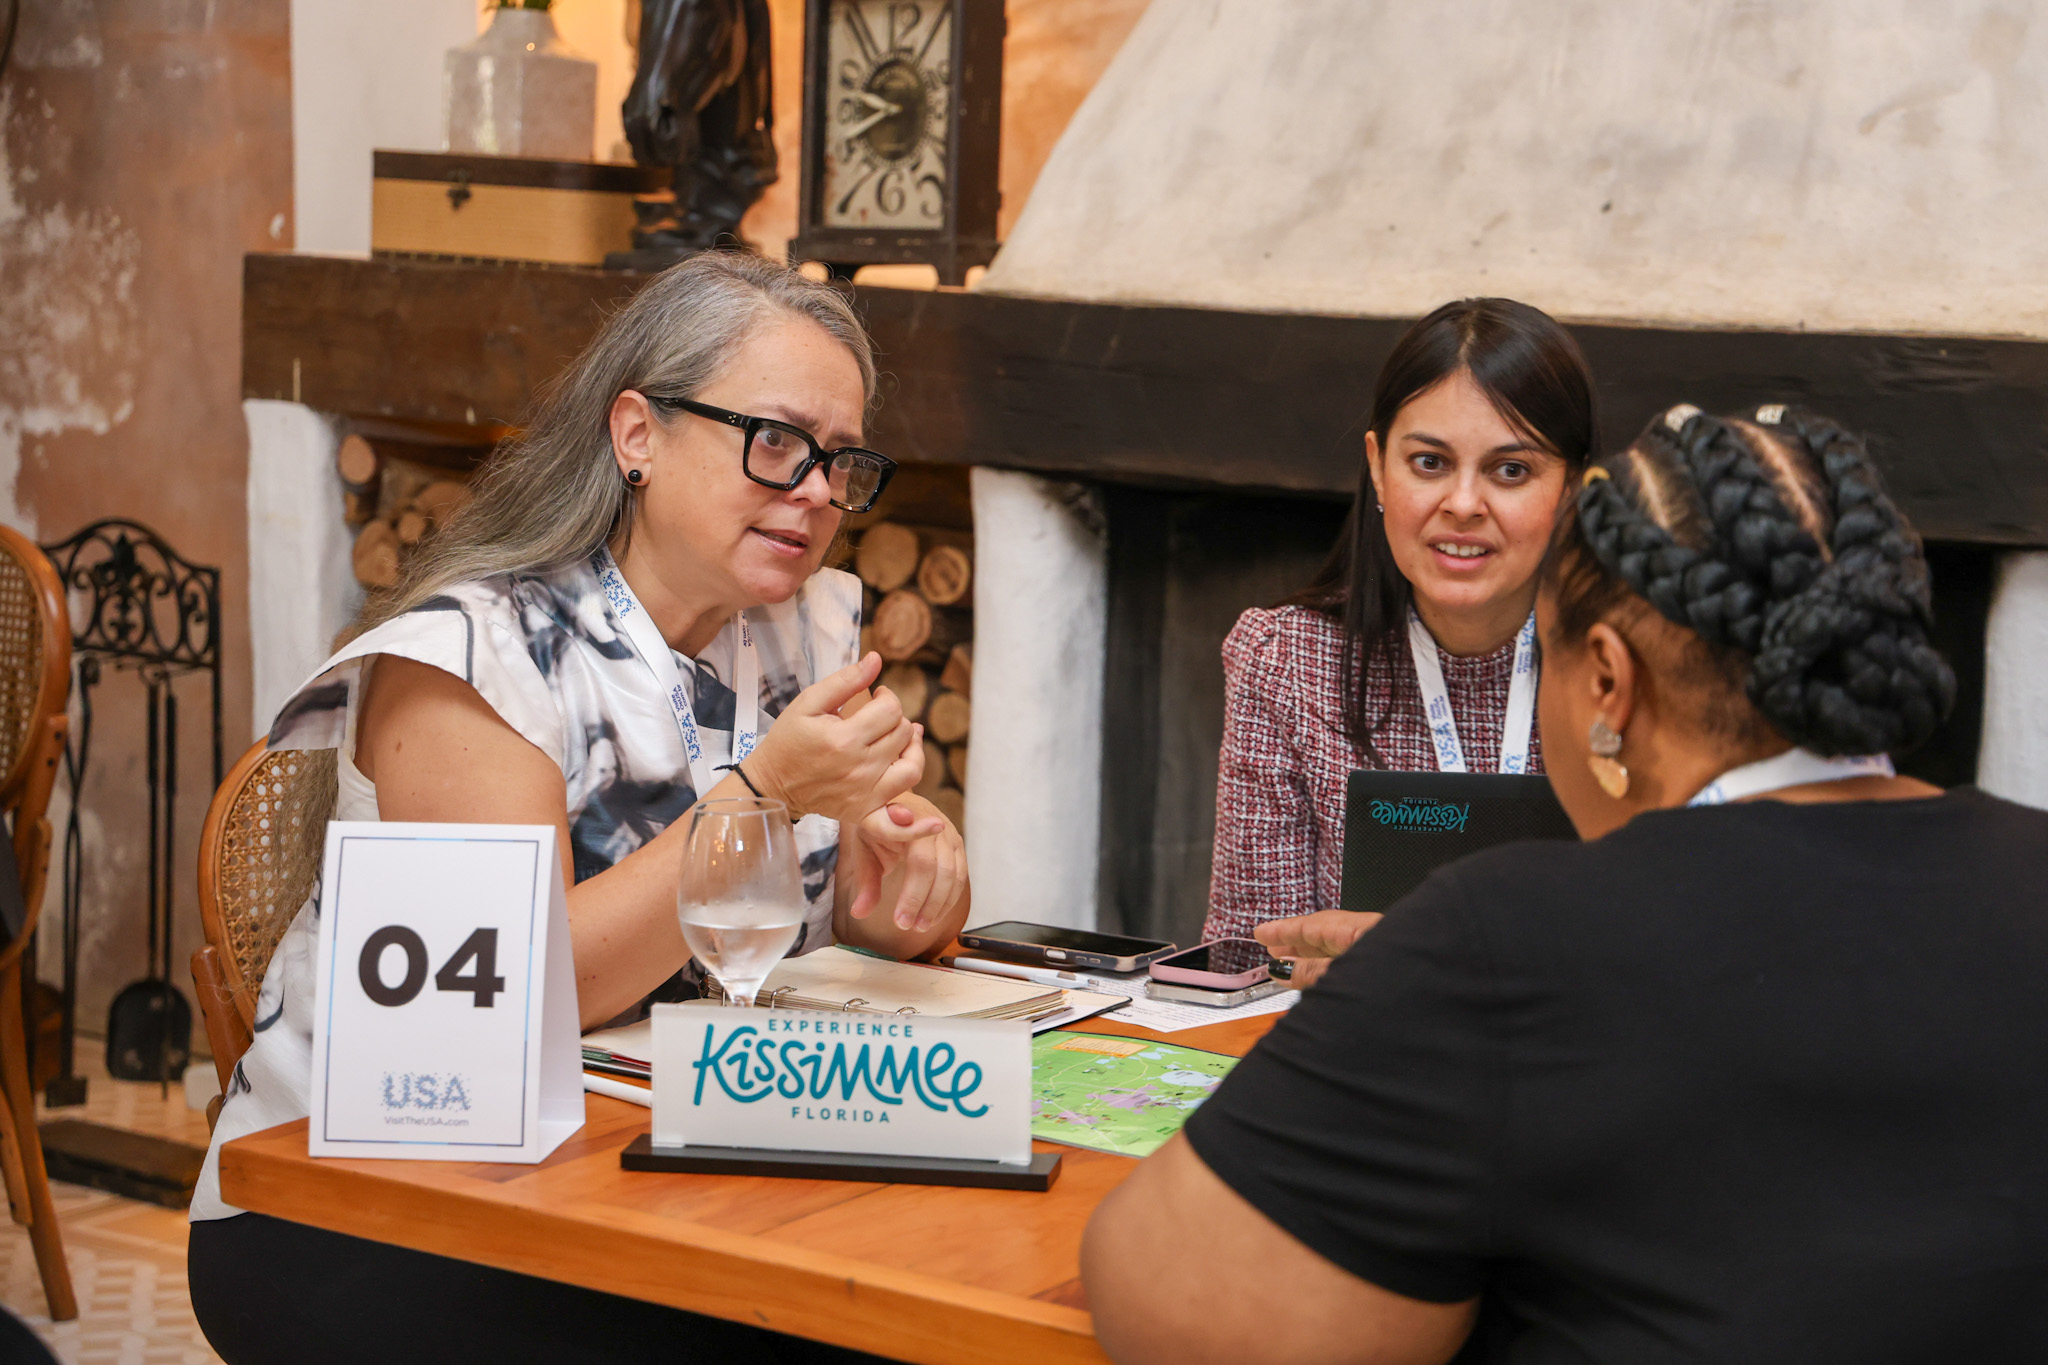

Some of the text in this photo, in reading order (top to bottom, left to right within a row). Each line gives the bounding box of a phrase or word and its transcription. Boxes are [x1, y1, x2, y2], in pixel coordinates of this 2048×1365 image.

[889, 3, 921, 54] 12
[875, 170, 906, 216] 6
[1371, 800, 1470, 831] Kissimmee
[1393, 825, 1442, 833] EXPERIENCE
[358, 924, 506, 1008] 04
[768, 1018, 914, 1038] EXPERIENCE
[692, 1023, 990, 1118] Kissimmee
[382, 1072, 471, 1110] USA
[384, 1116, 469, 1128] VisitTheUSA.com
[791, 1106, 890, 1123] FLORIDA
